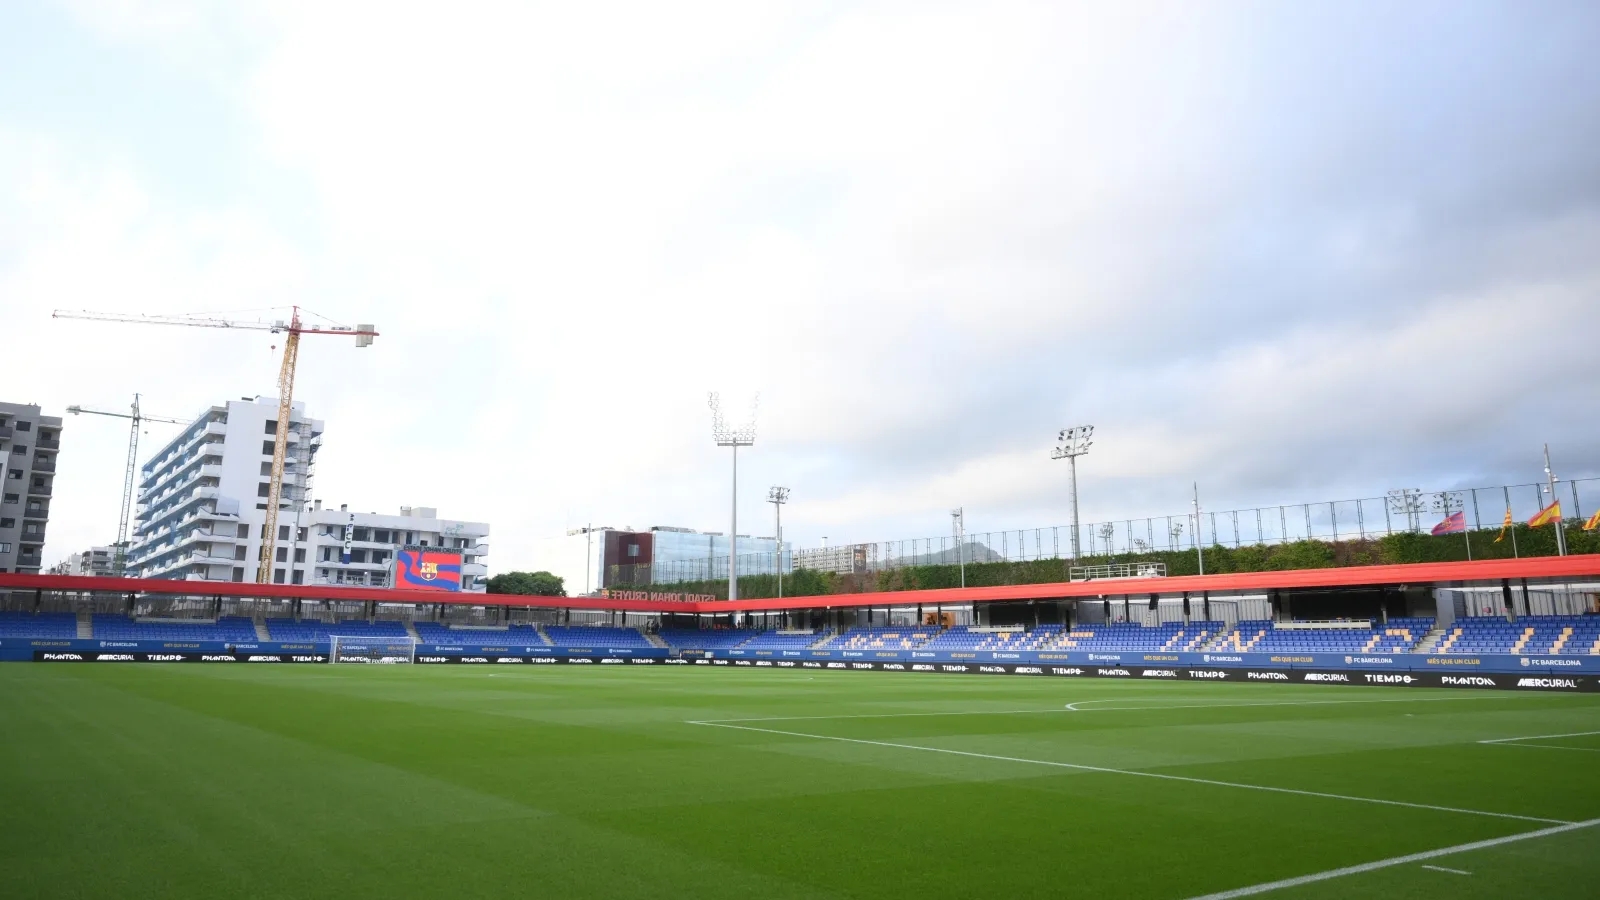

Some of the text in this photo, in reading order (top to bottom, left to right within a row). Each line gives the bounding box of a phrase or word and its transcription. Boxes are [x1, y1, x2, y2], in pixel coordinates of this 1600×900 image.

[1365, 675, 1418, 684] TIEMPO
[1442, 677, 1495, 686] PHANTOM
[1517, 679, 1577, 688] MERCURIAL
